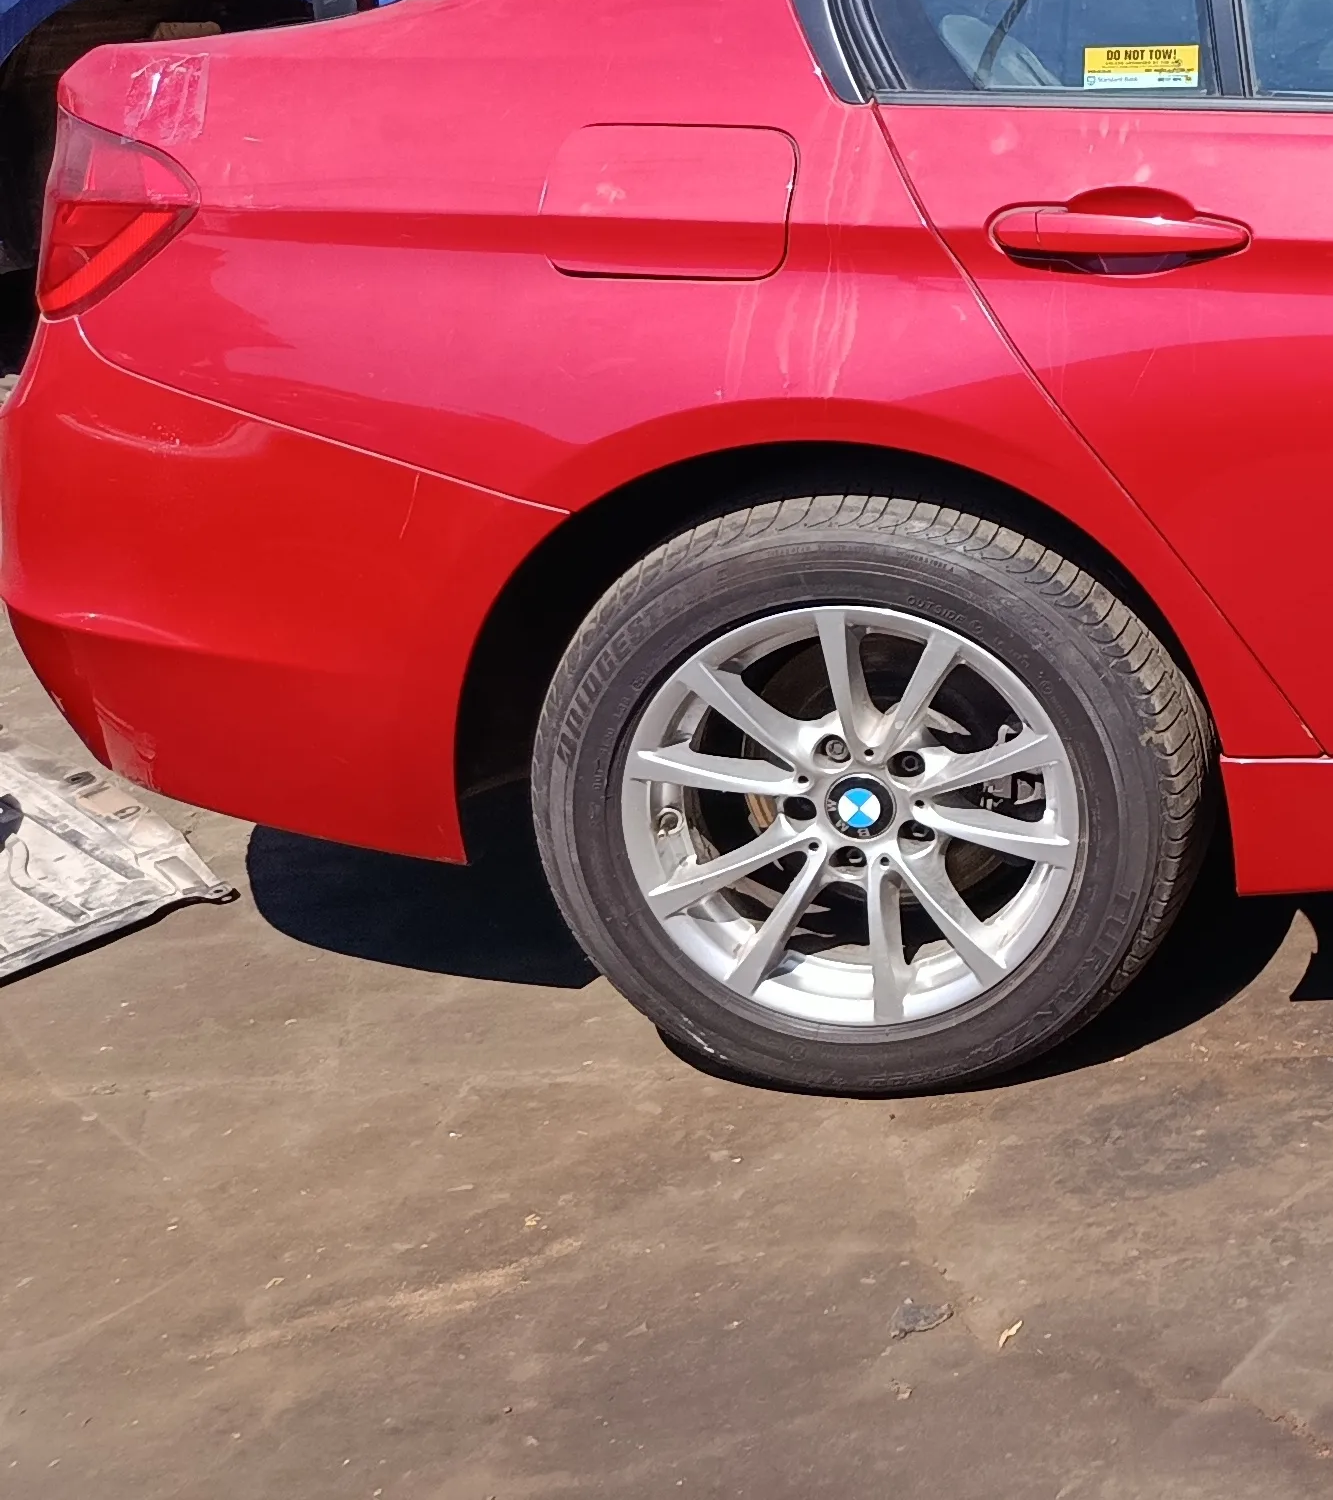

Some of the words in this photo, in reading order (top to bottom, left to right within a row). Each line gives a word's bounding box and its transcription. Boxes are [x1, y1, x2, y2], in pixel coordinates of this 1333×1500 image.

[1106, 49, 1121, 61] DO
[1124, 49, 1145, 61] NOT
[1149, 48, 1177, 60] TOW!
